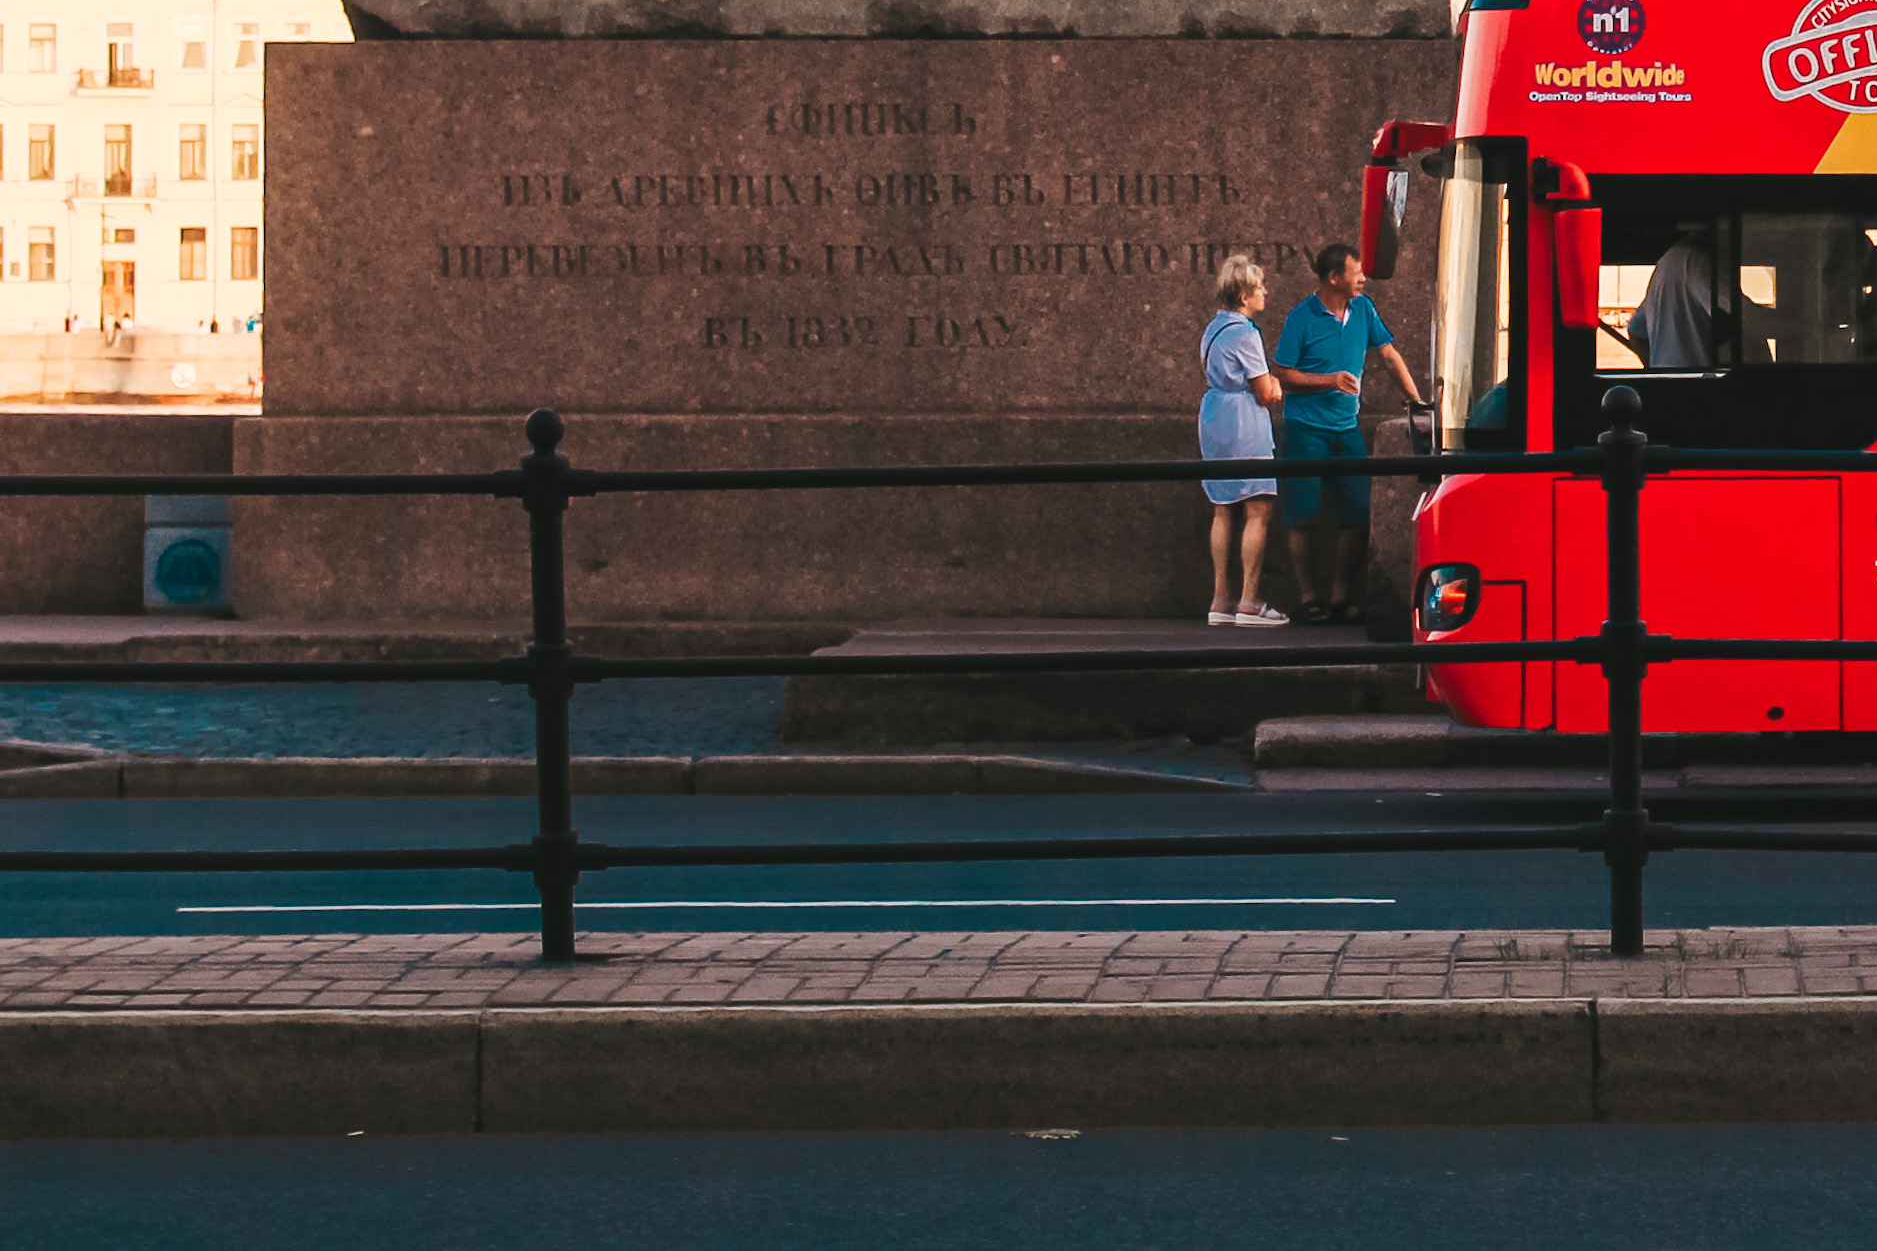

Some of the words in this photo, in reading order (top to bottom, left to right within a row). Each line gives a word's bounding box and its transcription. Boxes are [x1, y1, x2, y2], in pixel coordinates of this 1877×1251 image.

[1535, 60, 1685, 88] Worldwide
[1585, 91, 1656, 103] Sightseeing
[1658, 91, 1693, 102] Tours
